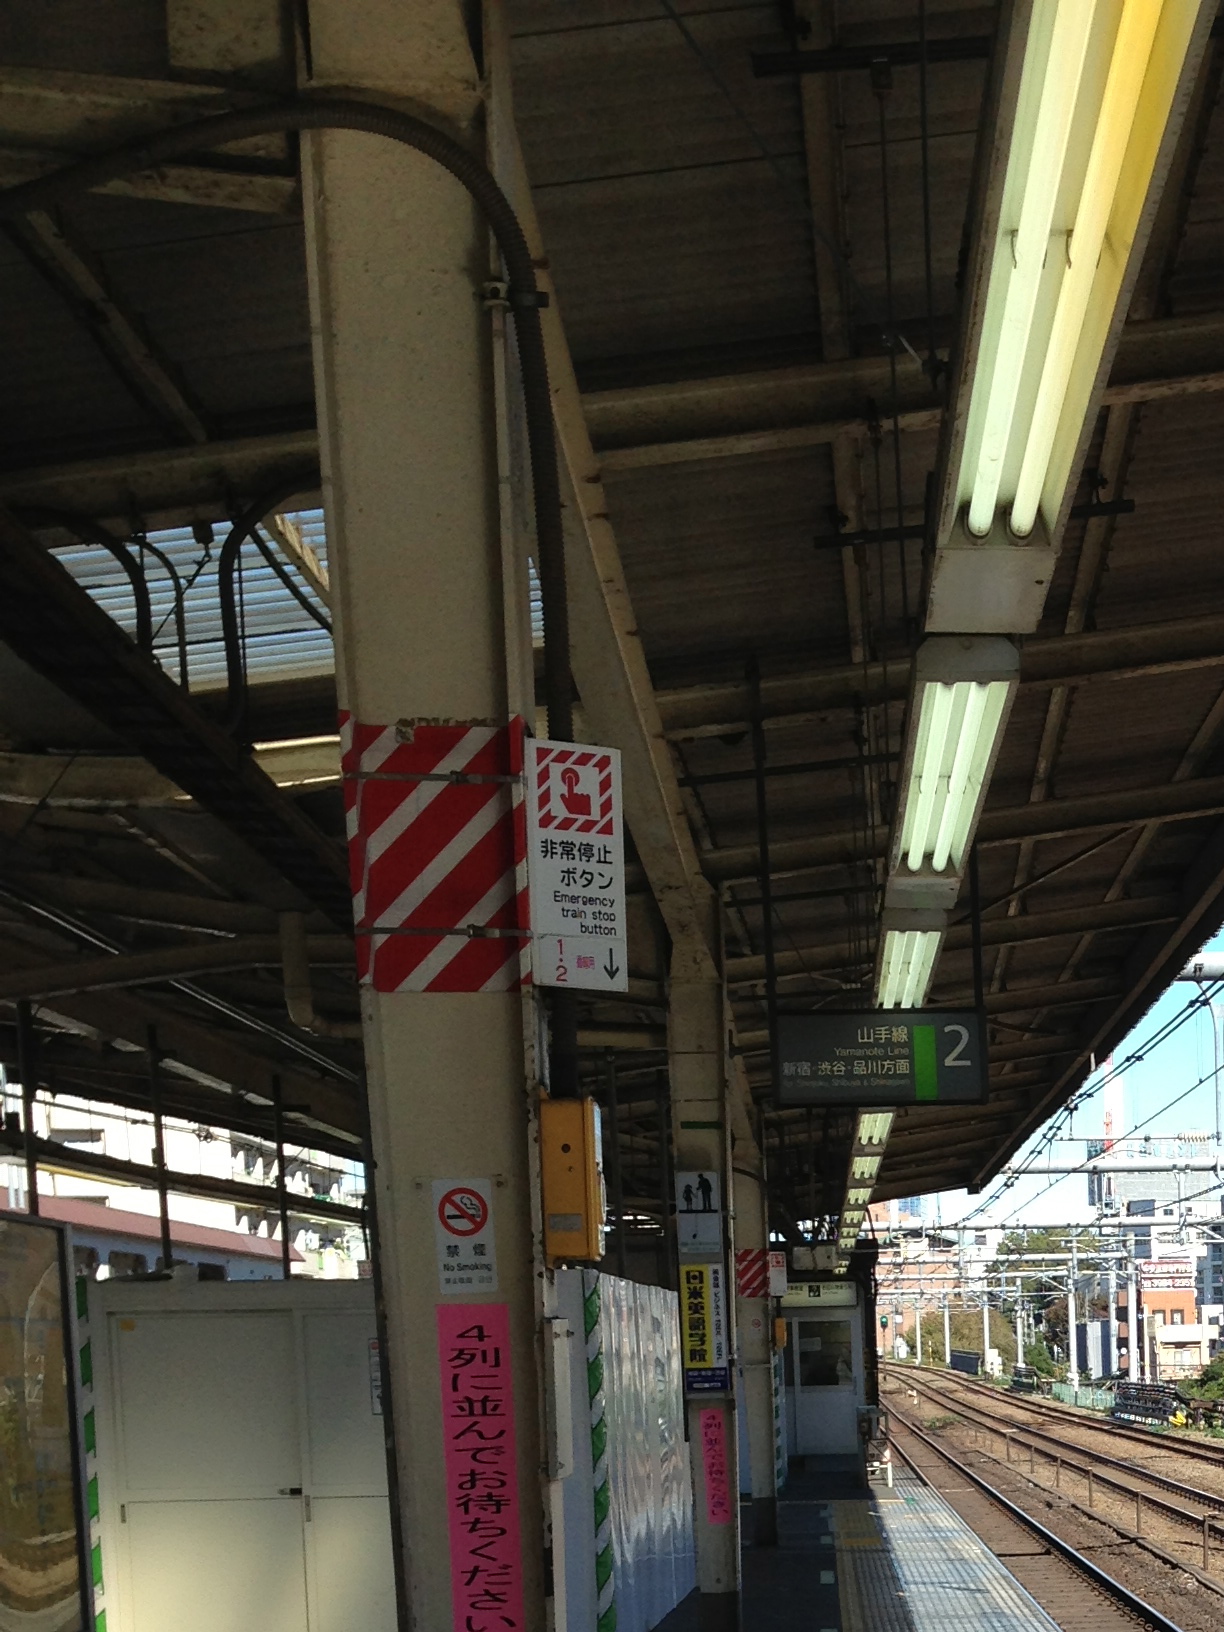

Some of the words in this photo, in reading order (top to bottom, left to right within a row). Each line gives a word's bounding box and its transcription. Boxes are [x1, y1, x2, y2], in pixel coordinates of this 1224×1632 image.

[540, 838, 613, 865] 非常停止
[560, 867, 613, 890] ボタン
[553, 890, 615, 907] Emergency
[561, 907, 587, 919] train
[592, 909, 616, 922] stop
[580, 922, 617, 936] button
[857, 1026, 909, 1043] 山手線
[833, 1047, 885, 1057] Yamanote
[887, 1046, 910, 1056] Line
[943, 1024, 972, 1067] 2
[443, 1263, 455, 1272] No
[456, 1262, 493, 1272] Smoking
